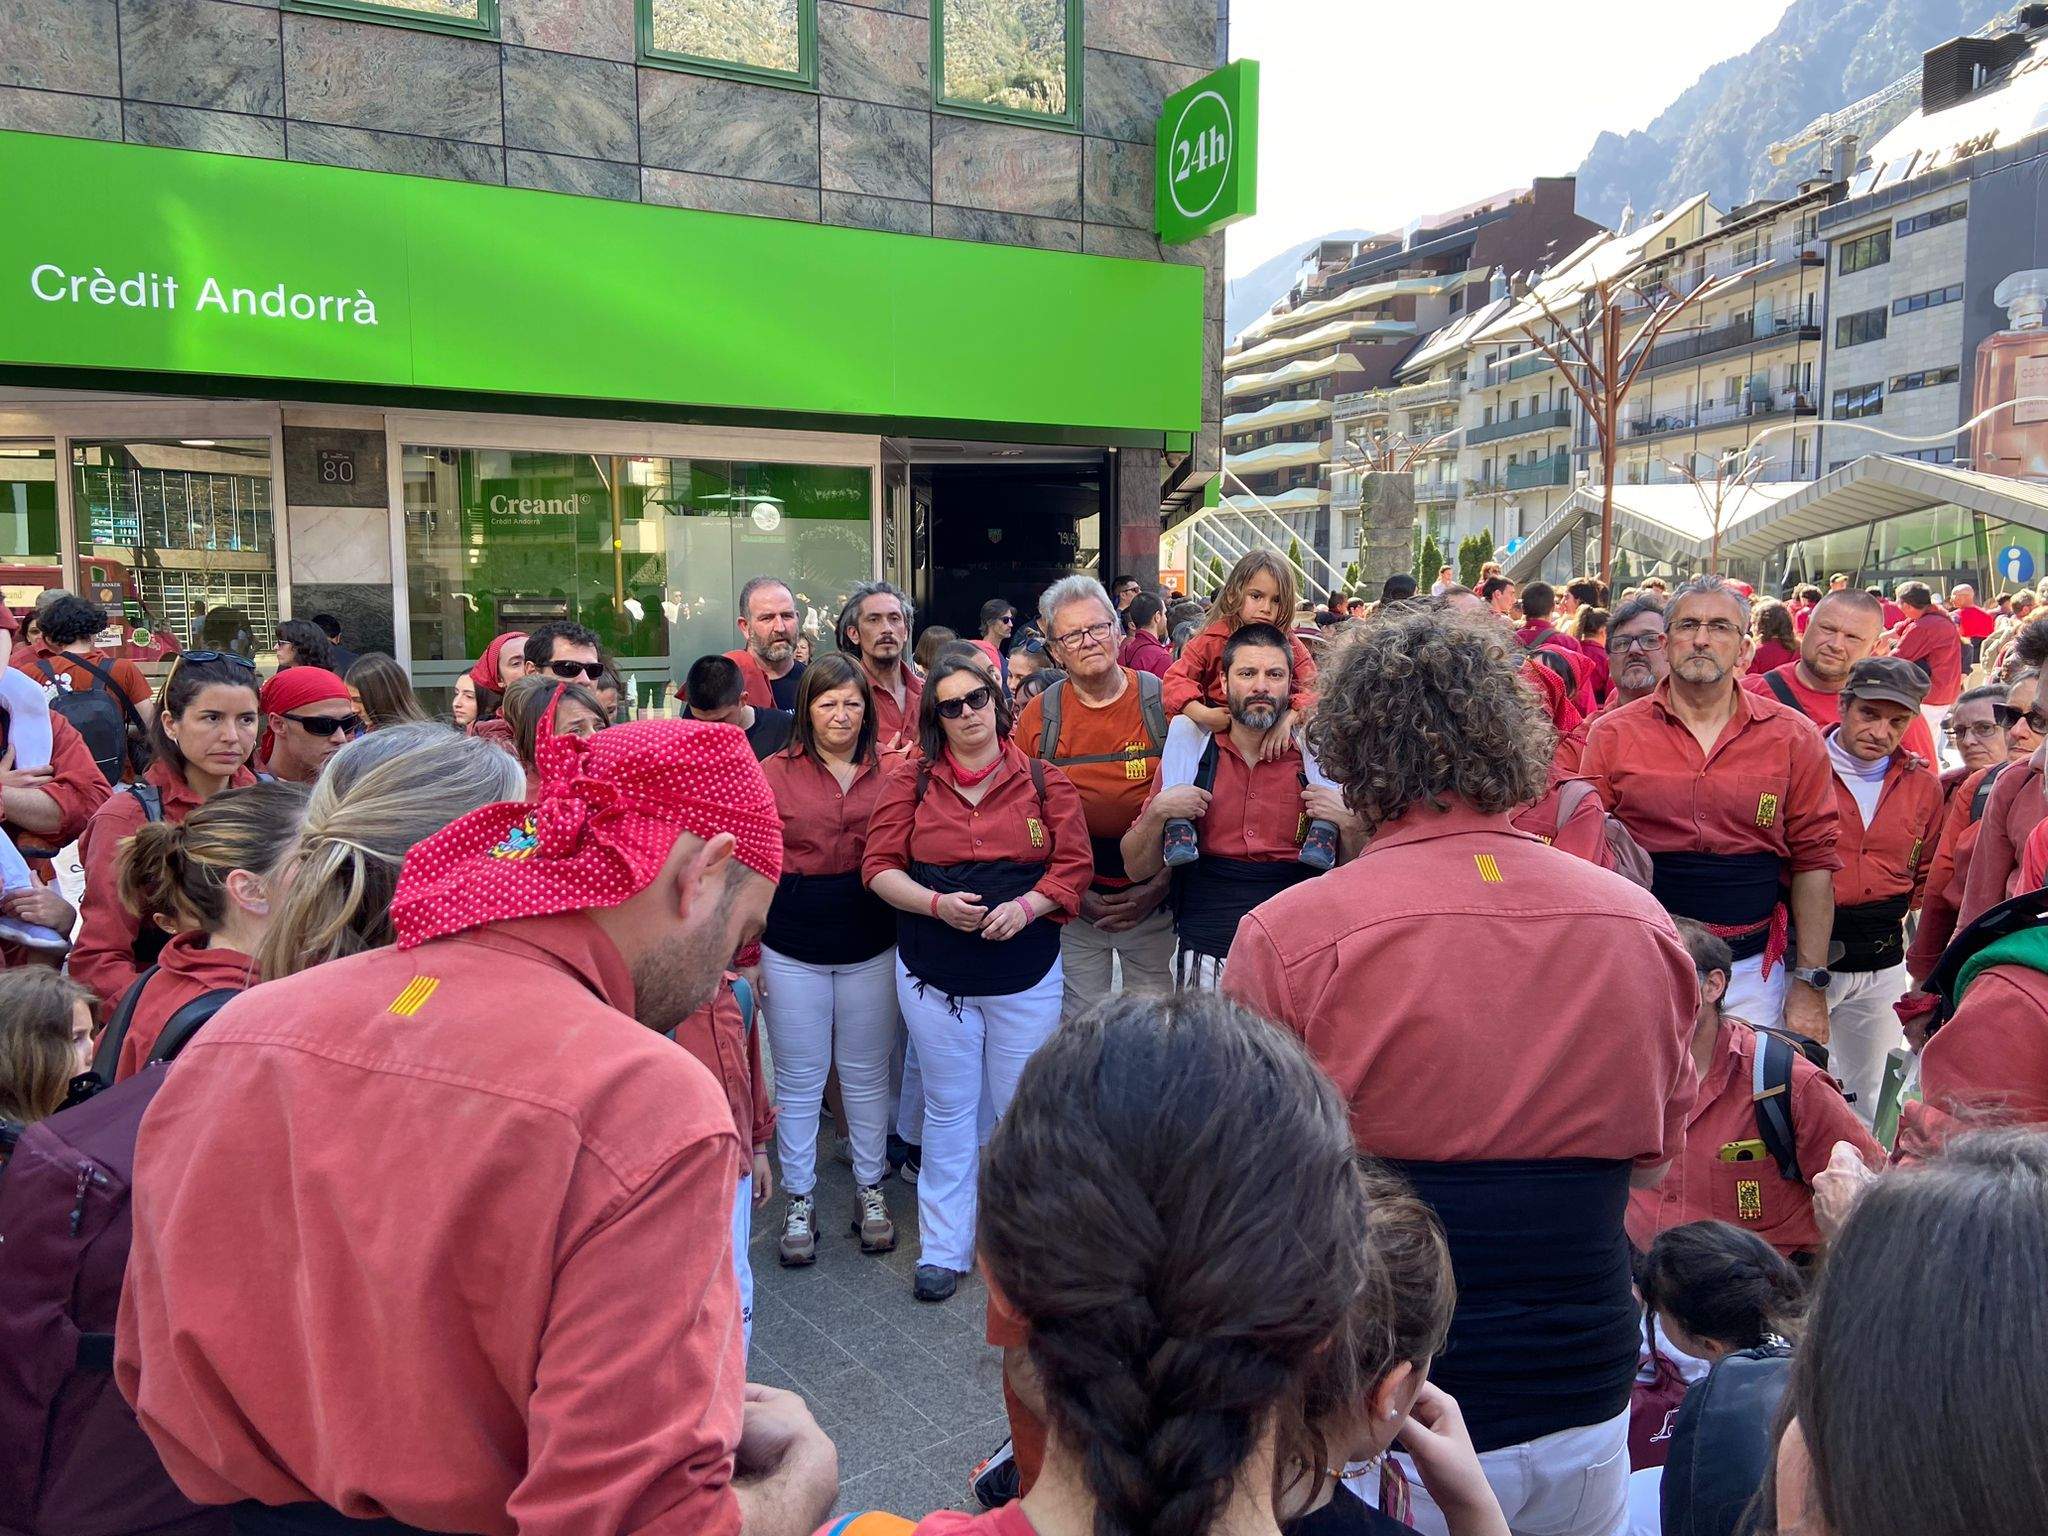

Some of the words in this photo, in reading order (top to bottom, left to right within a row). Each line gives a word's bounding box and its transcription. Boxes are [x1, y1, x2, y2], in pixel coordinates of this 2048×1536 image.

[1175, 125, 1225, 183] 24h
[31, 264, 178, 309] Crèdit
[196, 277, 378, 325] Andorrà
[324, 461, 353, 482] 80
